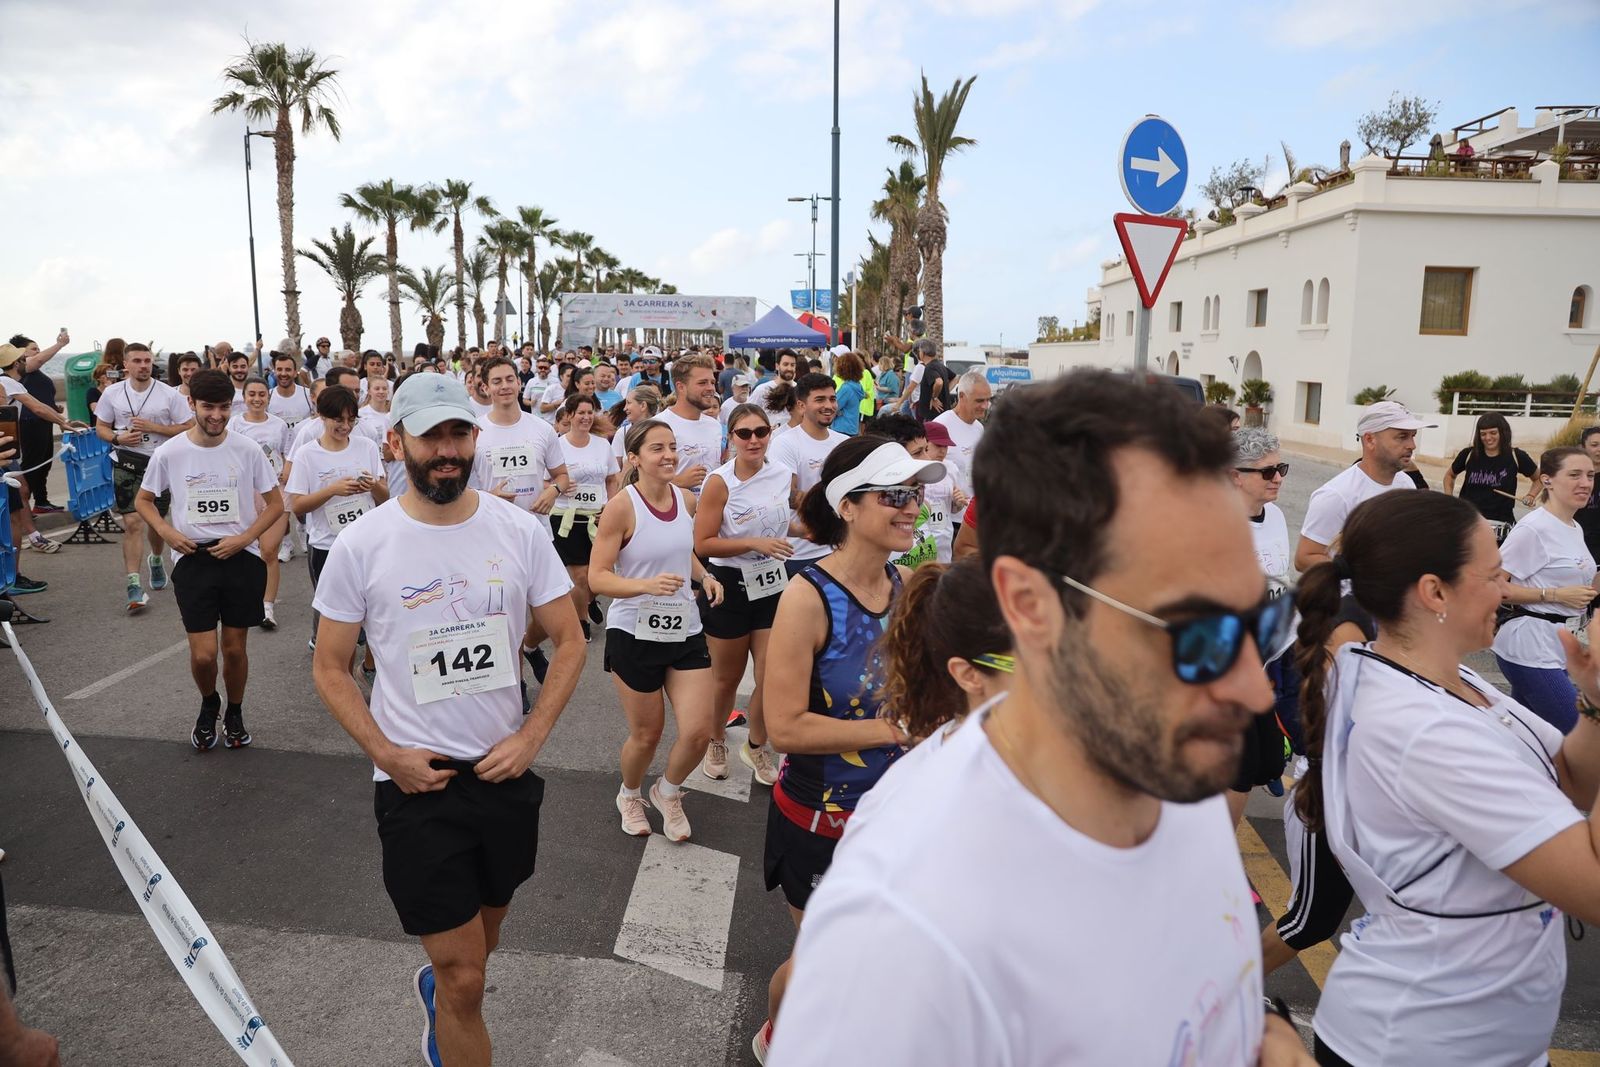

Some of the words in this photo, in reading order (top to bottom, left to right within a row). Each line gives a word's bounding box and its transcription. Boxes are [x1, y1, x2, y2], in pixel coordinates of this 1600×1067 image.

[624, 299, 635, 307] 3A
[637, 300, 680, 308] CARRERA
[123, 462, 135, 470] FILA
[500, 455, 528, 468] 713
[575, 492, 596, 502] 496
[197, 500, 230, 513] 595
[755, 567, 782, 587] 151
[648, 614, 683, 630] 632
[429, 629, 439, 637] 3A
[440, 623, 475, 634] CARRERA
[476, 621, 486, 629] 5K
[430, 644, 494, 677] 142
